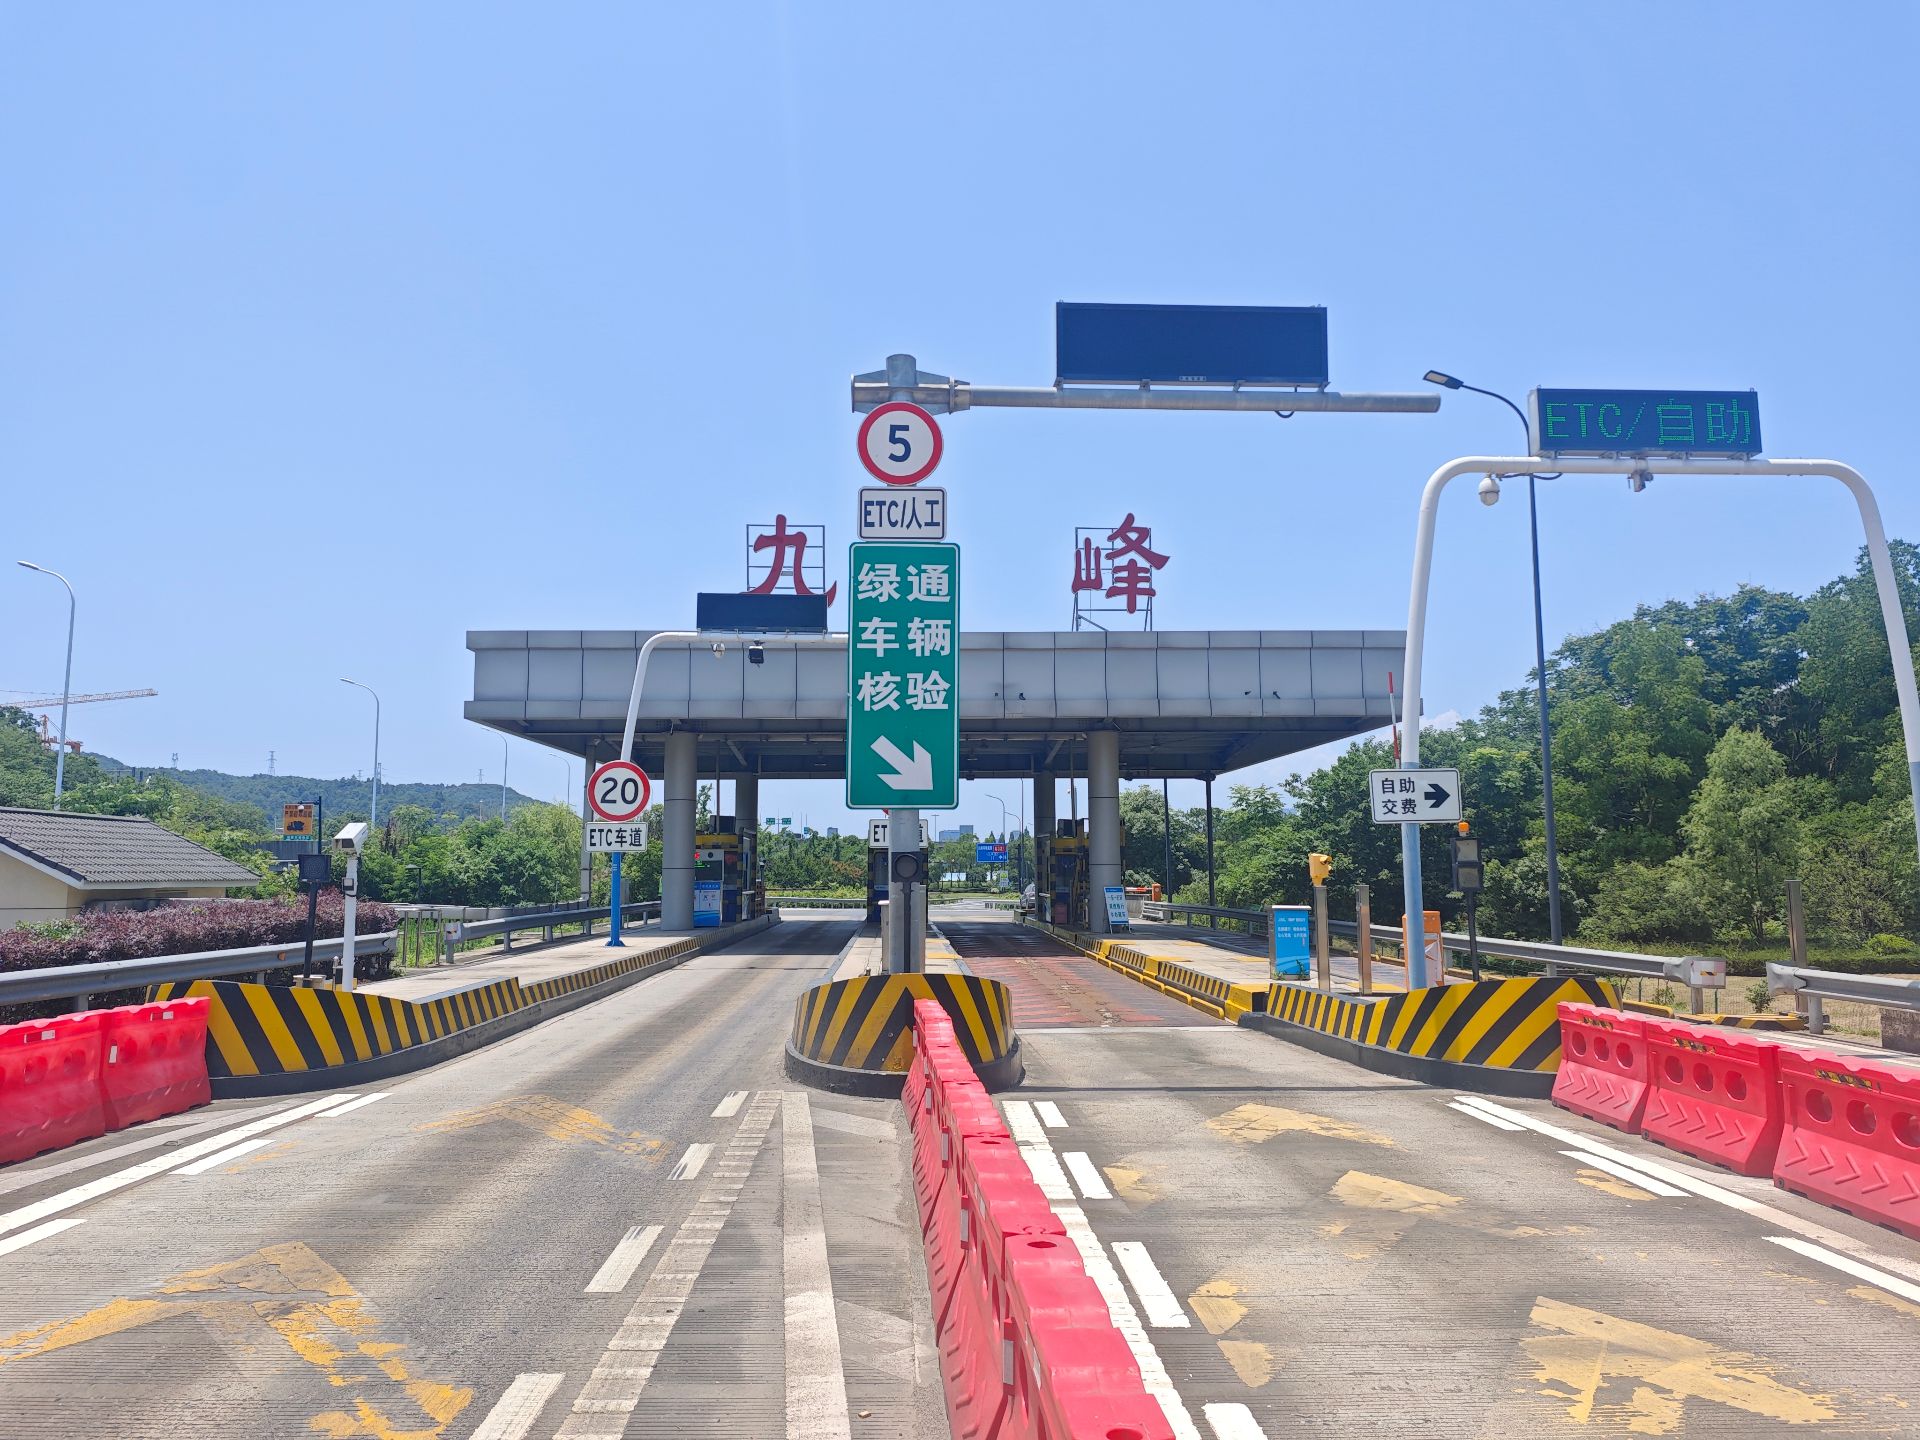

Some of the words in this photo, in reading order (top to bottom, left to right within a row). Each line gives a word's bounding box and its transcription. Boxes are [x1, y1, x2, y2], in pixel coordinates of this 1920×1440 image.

[1545, 398, 1751, 445] ETC/自助
[888, 425, 912, 462] 5
[863, 495, 941, 529] ETC/人工
[1071, 512, 1170, 614] 峰
[857, 563, 951, 603] 绿通
[856, 617, 951, 657] 车辆
[857, 670, 951, 711] 核验
[600, 777, 639, 804] 20
[1381, 777, 1416, 794] 自助
[1382, 798, 1417, 815] 交费
[589, 826, 643, 848] ETC车道
